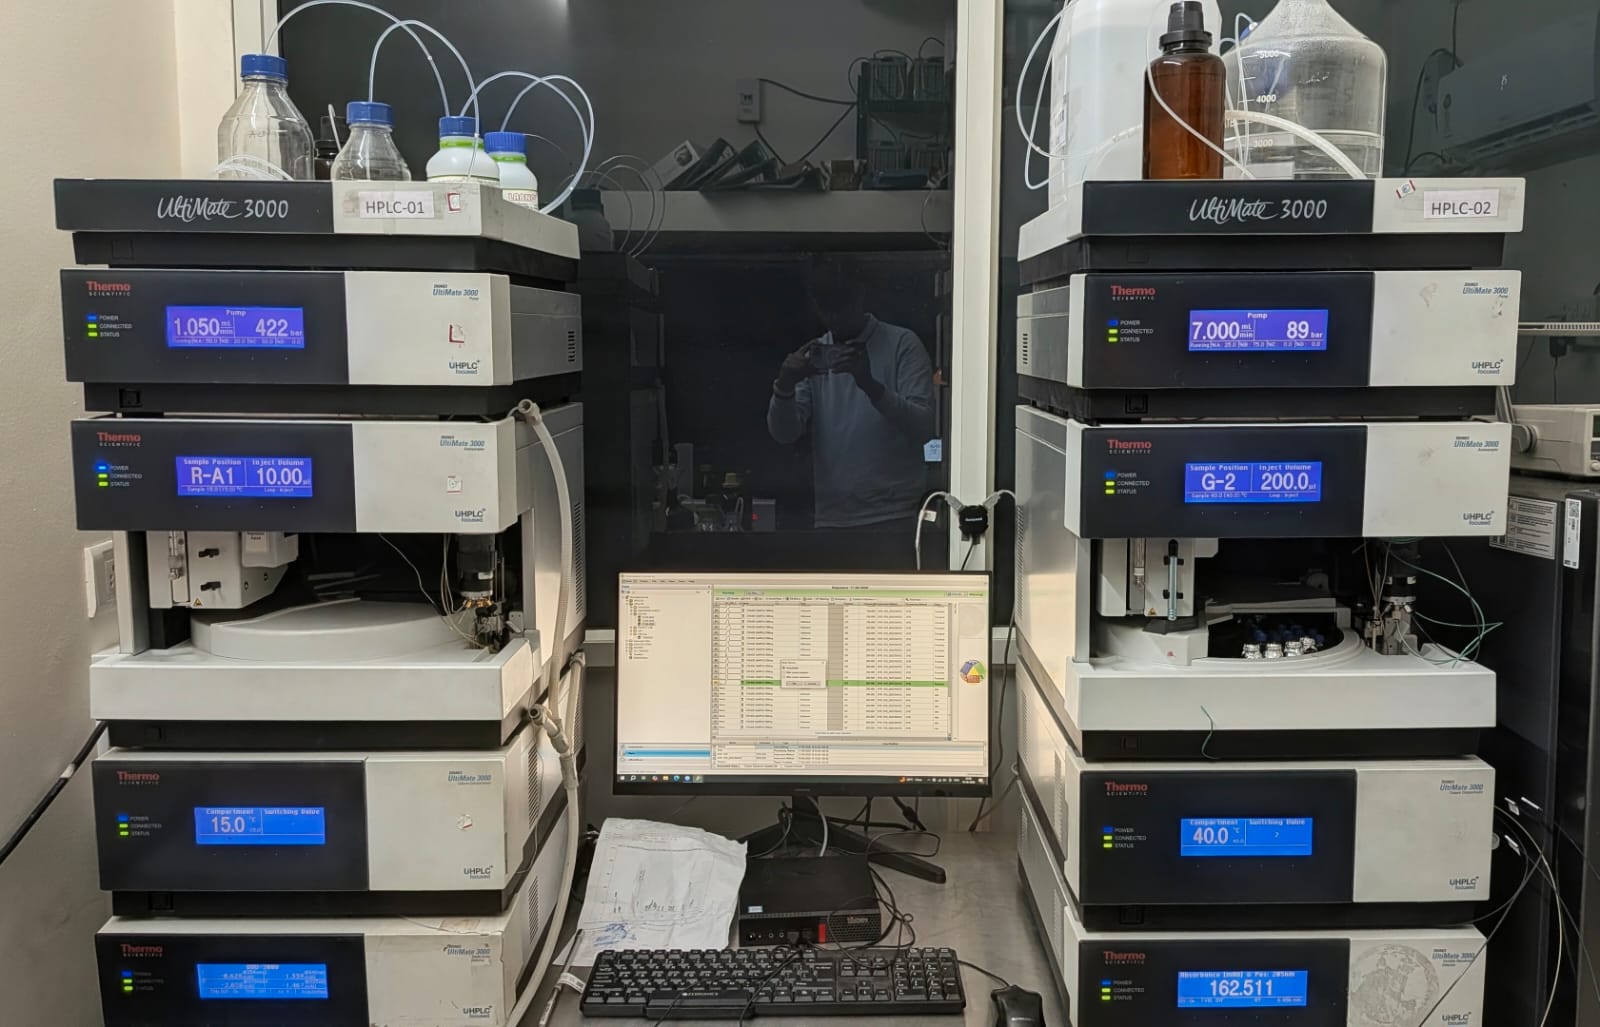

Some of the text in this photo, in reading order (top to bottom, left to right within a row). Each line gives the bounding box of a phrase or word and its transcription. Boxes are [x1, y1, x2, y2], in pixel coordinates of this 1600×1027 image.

[1256, 94, 1277, 102] 4000
[157, 195, 288, 222] UltiMate 3000
[365, 201, 424, 214] HPLC-01
[1189, 196, 1328, 224] UltiMate 3000
[1431, 201, 1492, 216] HPLC-02
[86, 281, 131, 290] Thermo
[1110, 286, 1156, 296] Thermo
[174, 318, 220, 336] 1.050
[255, 318, 288, 337] 422
[1192, 321, 1240, 340] 7.000
[1286, 320, 1310, 339] 89
[96, 432, 142, 442] Thermo
[1107, 440, 1152, 449] Thermo
[191, 466, 234, 485] R-A1
[1190, 464, 1216, 472] Sample
[1259, 464, 1282, 472] Inject
[256, 467, 303, 486] 10.00
[1202, 472, 1236, 491] G-2
[1261, 472, 1309, 491] 200.0
[116, 770, 160, 780] Thermo
[1104, 781, 1149, 792] Thermo
[212, 816, 246, 833] 15.0
[1193, 826, 1229, 845] 40.0
[1104, 950, 1146, 960] Thermo
[1210, 980, 1273, 996] 162.511
